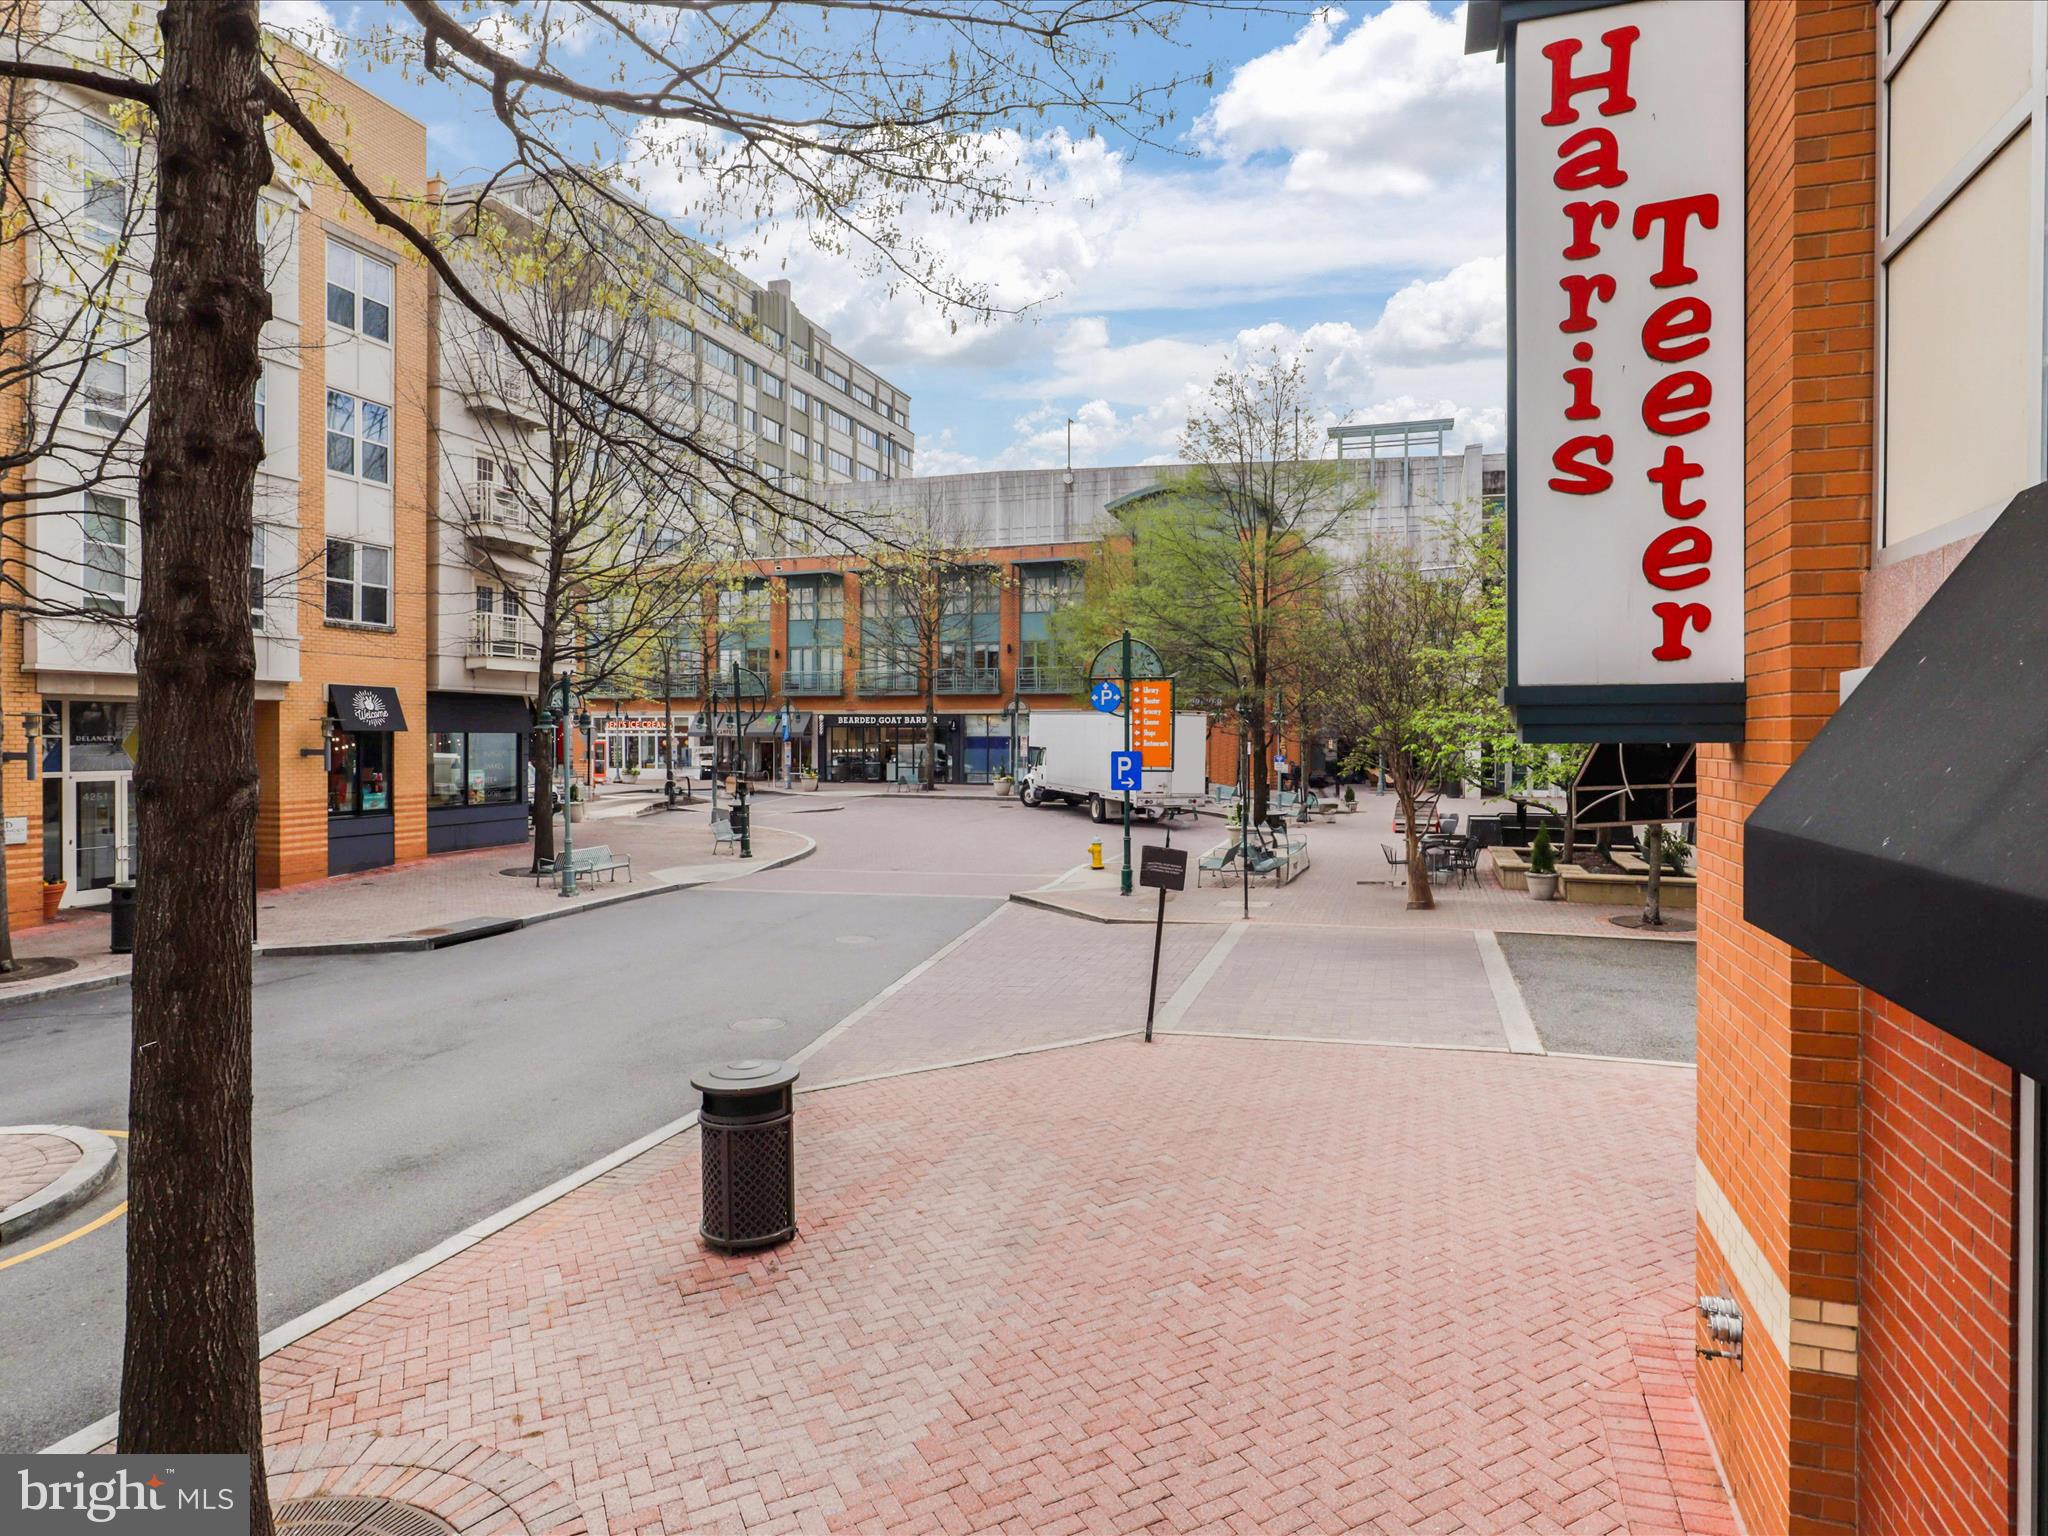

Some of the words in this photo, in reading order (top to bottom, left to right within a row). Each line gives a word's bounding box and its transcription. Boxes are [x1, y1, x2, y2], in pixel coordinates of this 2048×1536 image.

[1541, 25, 1640, 495] Harris
[1632, 193, 1719, 661] Teeter
[1100, 690, 1113, 706] P
[354, 708, 389, 720] Welcome
[838, 716, 876, 724] BEARDED
[878, 716, 902, 724] GOAT
[904, 716, 938, 724] BARBR
[628, 720, 640, 728] ICE
[1117, 756, 1132, 780] P
[82, 792, 109, 801] 4251
